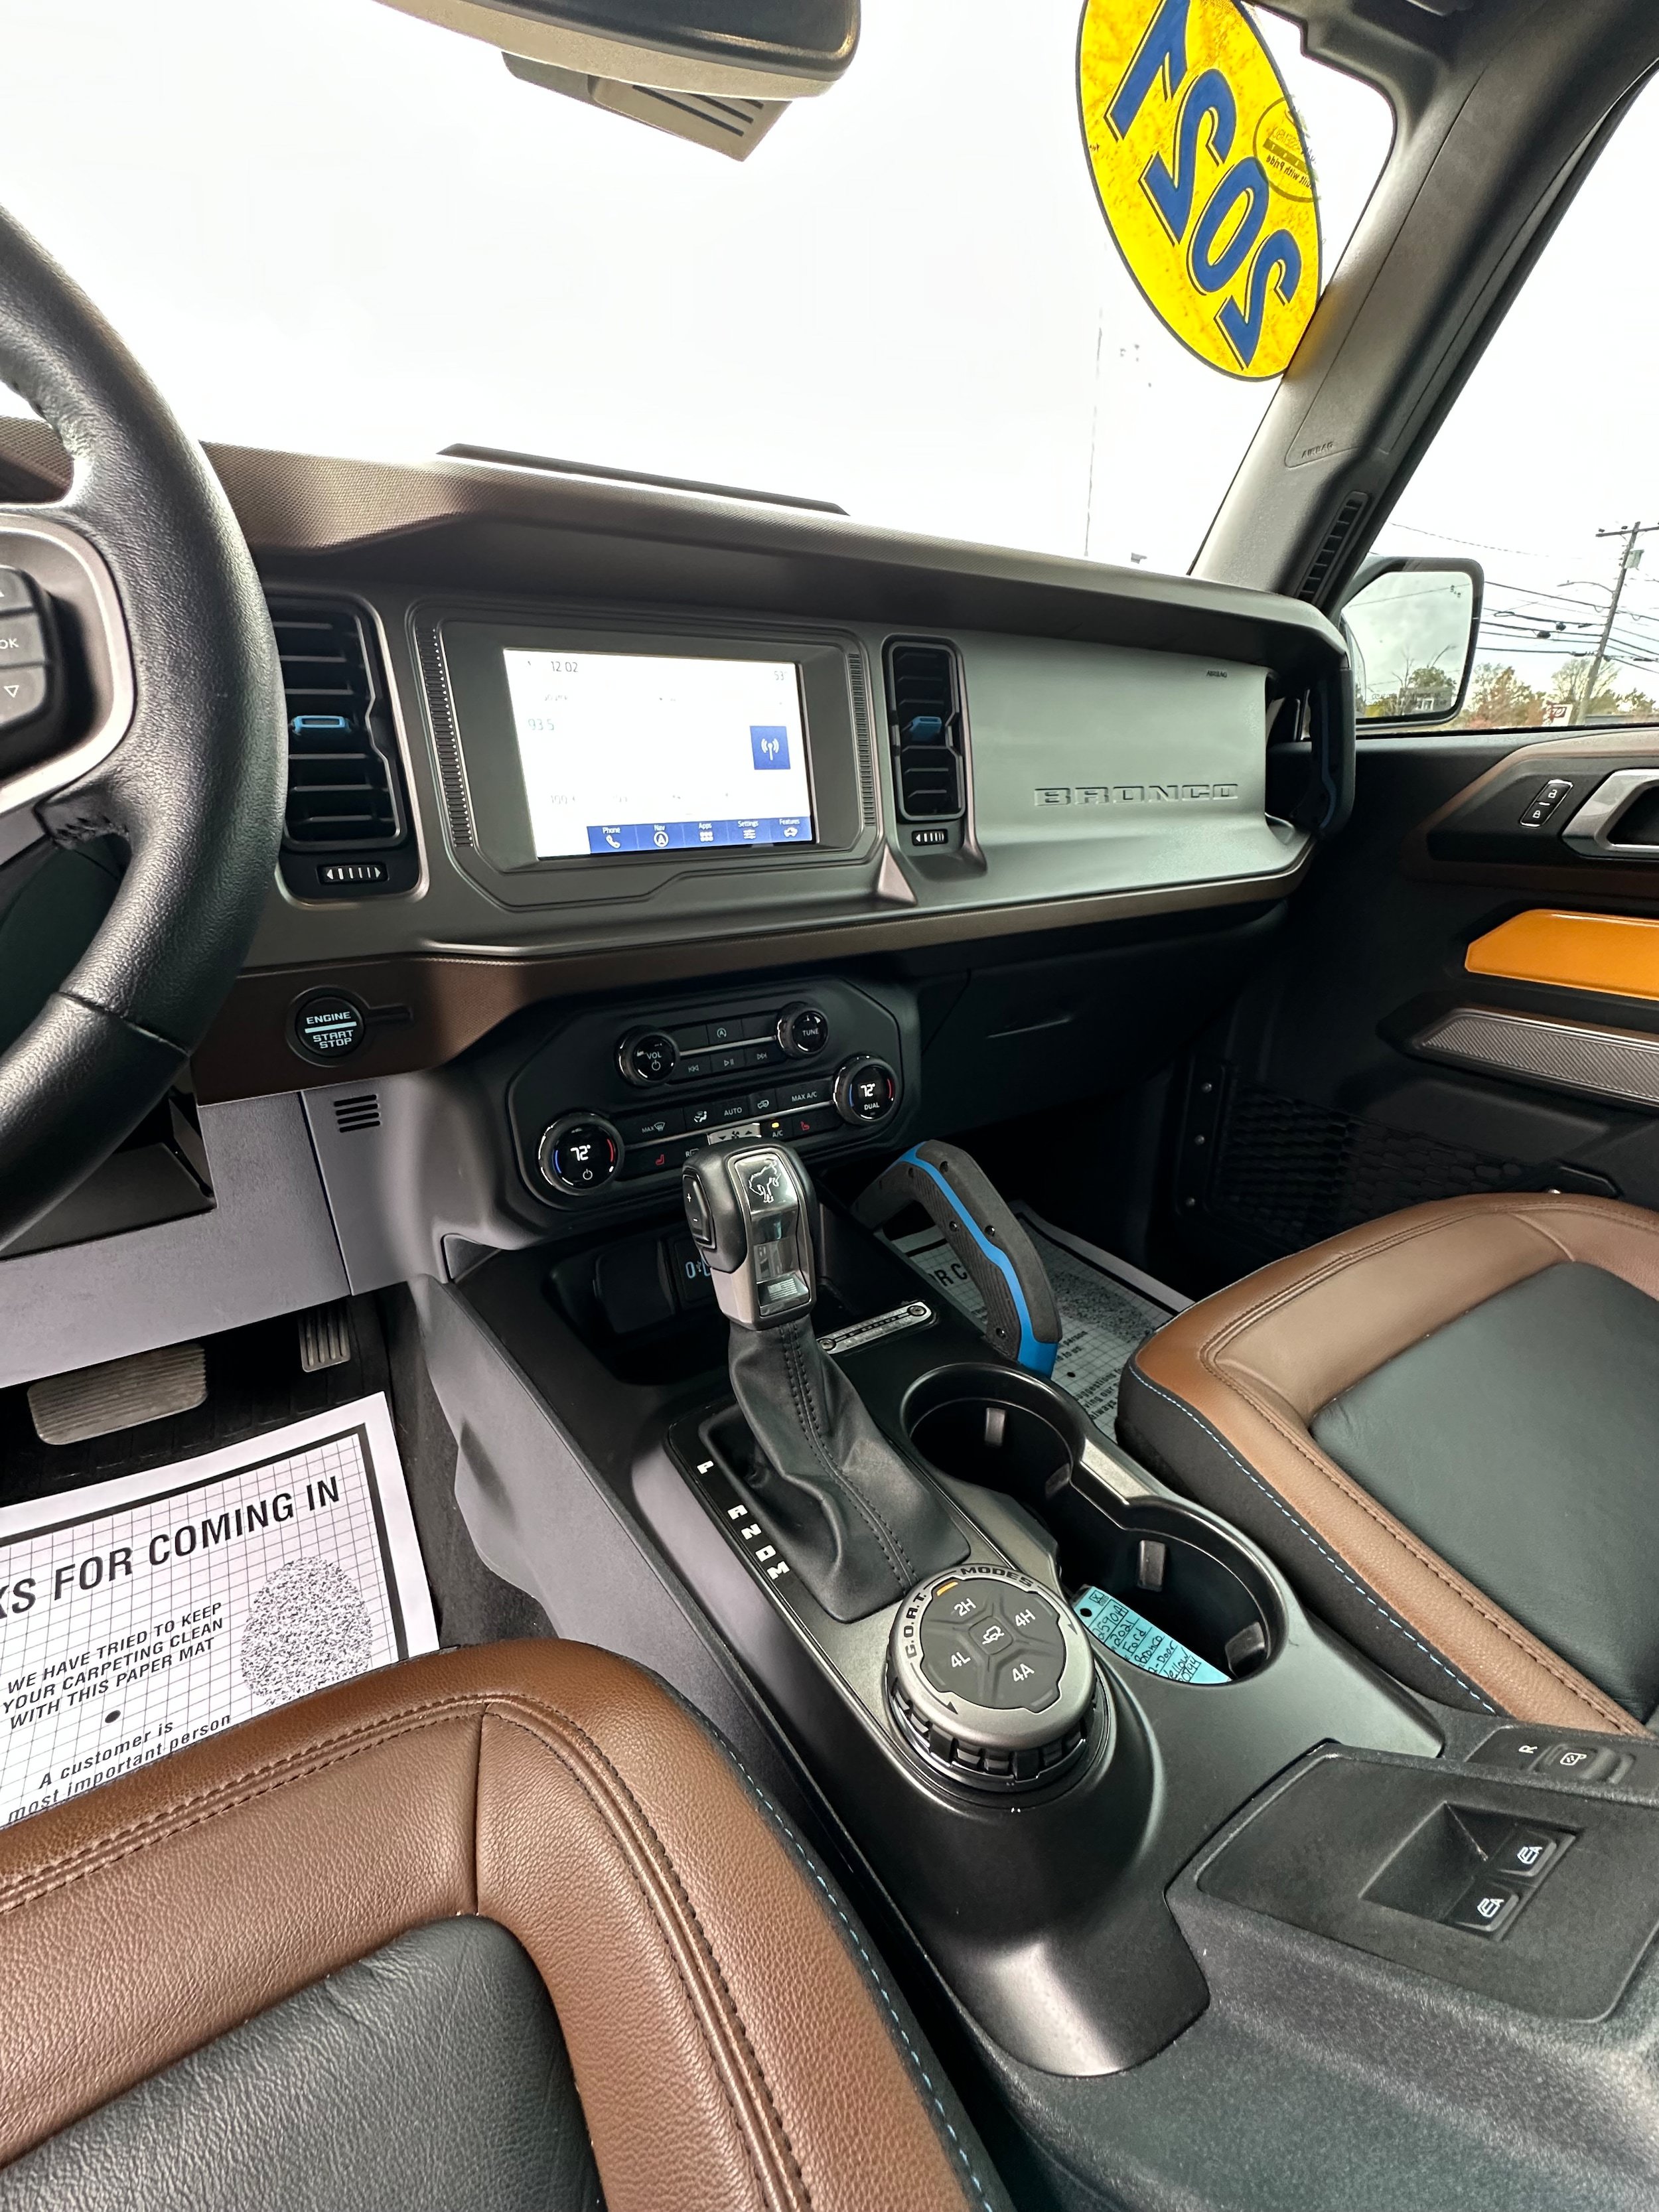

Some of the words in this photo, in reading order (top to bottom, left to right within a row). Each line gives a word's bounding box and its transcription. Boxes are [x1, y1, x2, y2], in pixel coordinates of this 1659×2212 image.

[1034, 784, 1238, 806] BRONCO
[738, 820, 758, 828] Settings
[306, 1011, 351, 1024] ENGINE
[313, 1031, 353, 1042] START
[320, 1038, 352, 1049] STOP
[646, 1051, 662, 1060] VOL
[791, 1094, 806, 1102] MAX
[724, 1107, 743, 1116] AUTO
[697, 1460, 713, 1474] P
[54, 1547, 133, 1600] FOR
[149, 1492, 294, 1566] COMING
[307, 1476, 340, 1511] IN
[741, 1523, 761, 1540] N
[766, 1561, 790, 1580] M
[960, 1566, 1034, 1587] MODES
[954, 1598, 976, 1616] 2H
[1015, 1609, 1036, 1627] 4H
[8, 1672, 37, 1694] WE
[43, 1651, 90, 1680] HAVE
[97, 1631, 147, 1659] TRIED
[154, 1620, 175, 1637] TO
[182, 1602, 222, 1627] KEEP
[1123, 1627, 1147, 1657] Ford
[3, 1684, 56, 1714] YOUR
[63, 1641, 163, 1690] CARPETING
[170, 1618, 223, 1648] CLEAN
[950, 1652, 971, 1668] 4L
[1012, 1663, 1035, 1682] 4A
[11, 1698, 60, 1729] WITH
[67, 1679, 109, 1706] THIS
[116, 1655, 173, 1686] PAPER
[179, 1637, 214, 1661] MAT
[38, 1772, 52, 1789] A
[60, 1731, 151, 1779] customer
[158, 1722, 173, 1737] is
[1519, 1745, 1538, 1753] R
[8, 1789, 59, 1822] most
[67, 1743, 162, 1797] important
[170, 1714, 231, 1752] person
